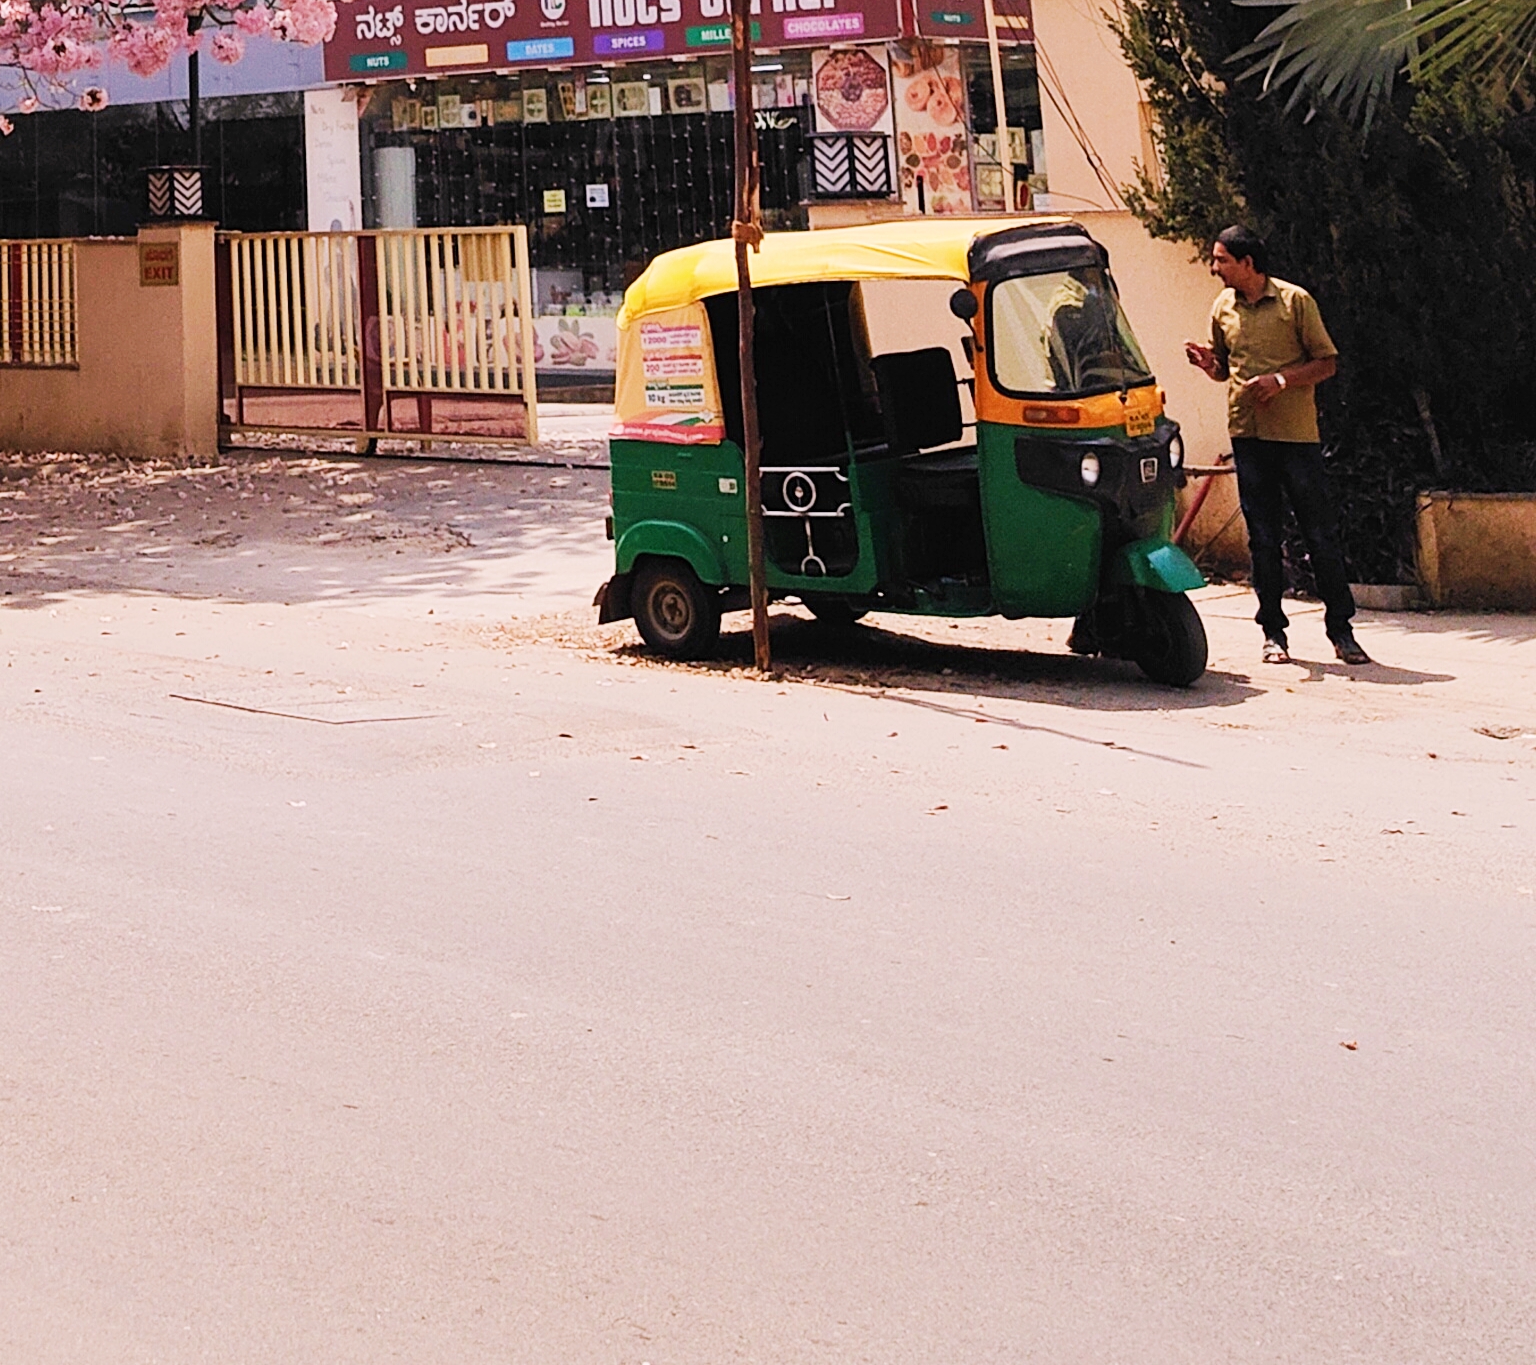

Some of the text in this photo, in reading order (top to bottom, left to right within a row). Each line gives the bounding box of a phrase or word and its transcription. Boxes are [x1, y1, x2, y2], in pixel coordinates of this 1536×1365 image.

[787, 18, 860, 35] CHOCOLATES
[611, 35, 647, 49] SPICES
[701, 28, 732, 42] MILLE
[525, 43, 555, 56] DATES
[366, 55, 390, 67] NUTS
[144, 265, 173, 279] EXIT
